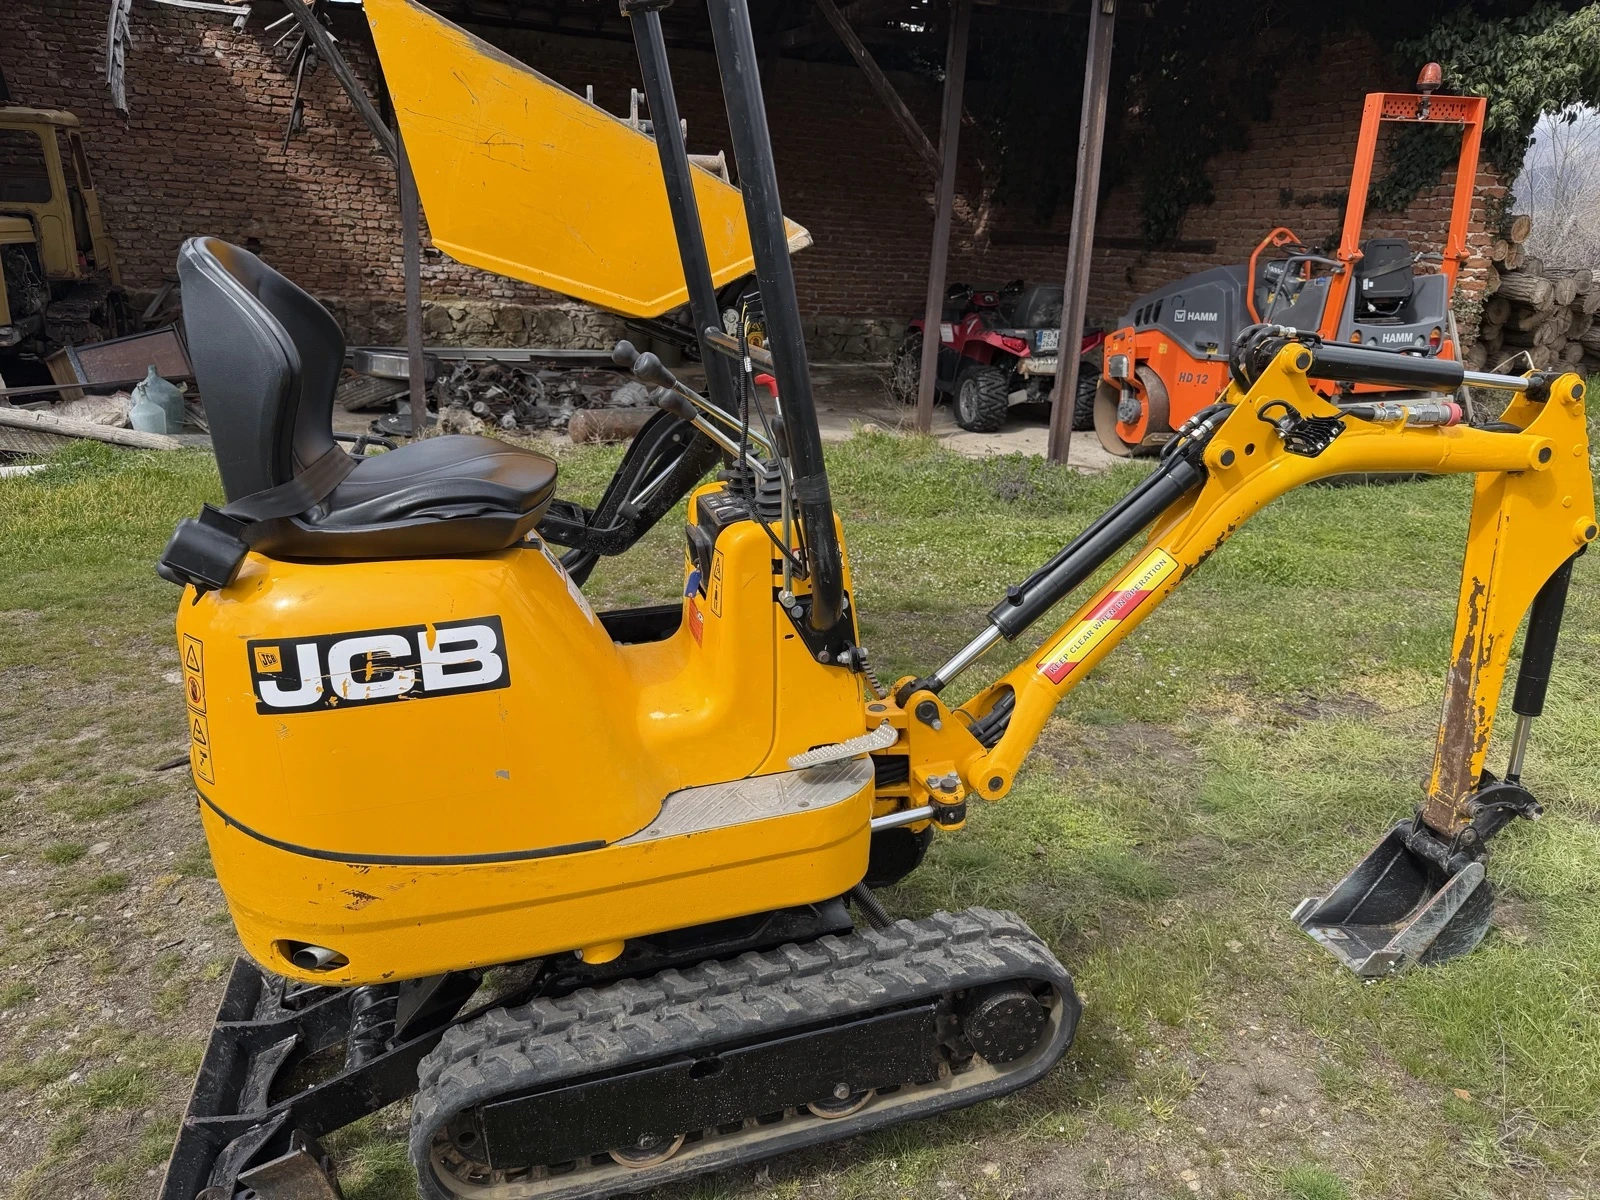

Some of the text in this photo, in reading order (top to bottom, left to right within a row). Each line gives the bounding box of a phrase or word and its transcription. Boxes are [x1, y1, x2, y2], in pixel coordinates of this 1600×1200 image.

[1187, 311, 1218, 322] HAMM
[1382, 332, 1414, 343] HAMM
[1178, 372, 1209, 385] HD 12
[1049, 558, 1167, 674] KEEP CLEAR WHEN IN OPERATION
[259, 624, 503, 708] JCB
[261, 653, 277, 666] JCB
